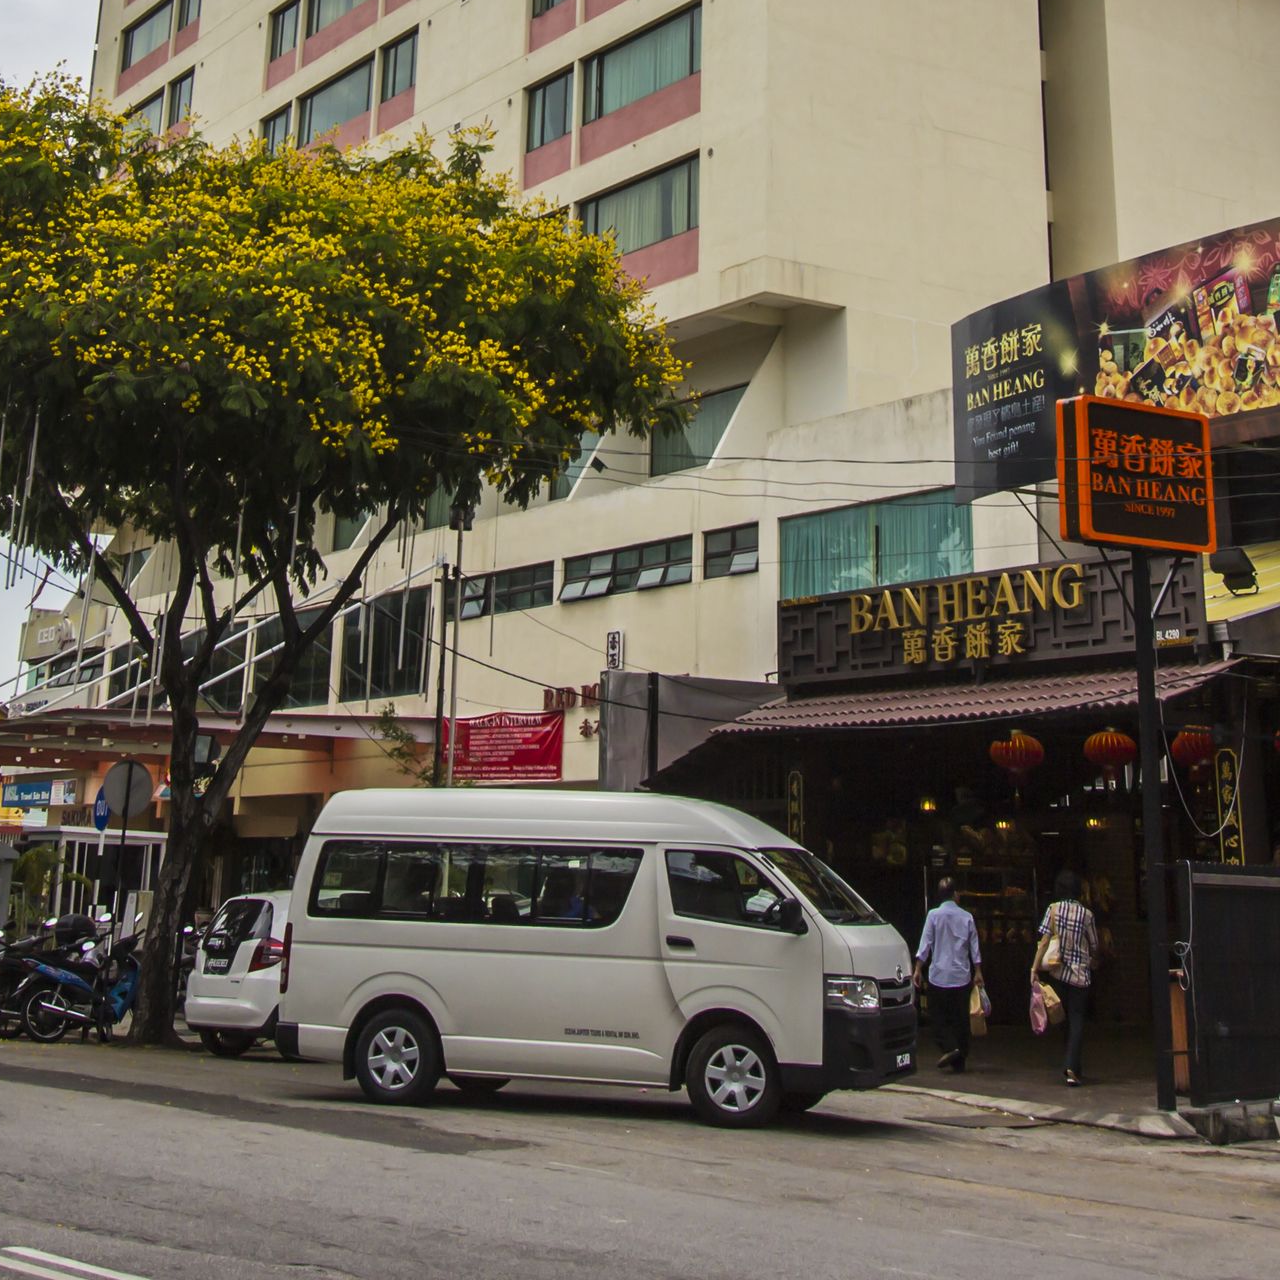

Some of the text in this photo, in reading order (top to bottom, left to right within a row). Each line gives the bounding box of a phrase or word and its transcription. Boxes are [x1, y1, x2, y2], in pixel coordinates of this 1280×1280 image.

[964, 323, 1043, 380] 萬香餅家
[967, 369, 1045, 411] BAN HEANG
[1091, 428, 1205, 479] 萬香餅家
[1092, 472, 1206, 507] BAN HEANG
[1124, 503, 1175, 518] SINCE 1997
[848, 562, 1085, 634] BAN HEANG
[901, 620, 1026, 666] 萬香餅家
[543, 686, 577, 712] RED
[469, 715, 543, 729] WALK-IN INTERVIEW
